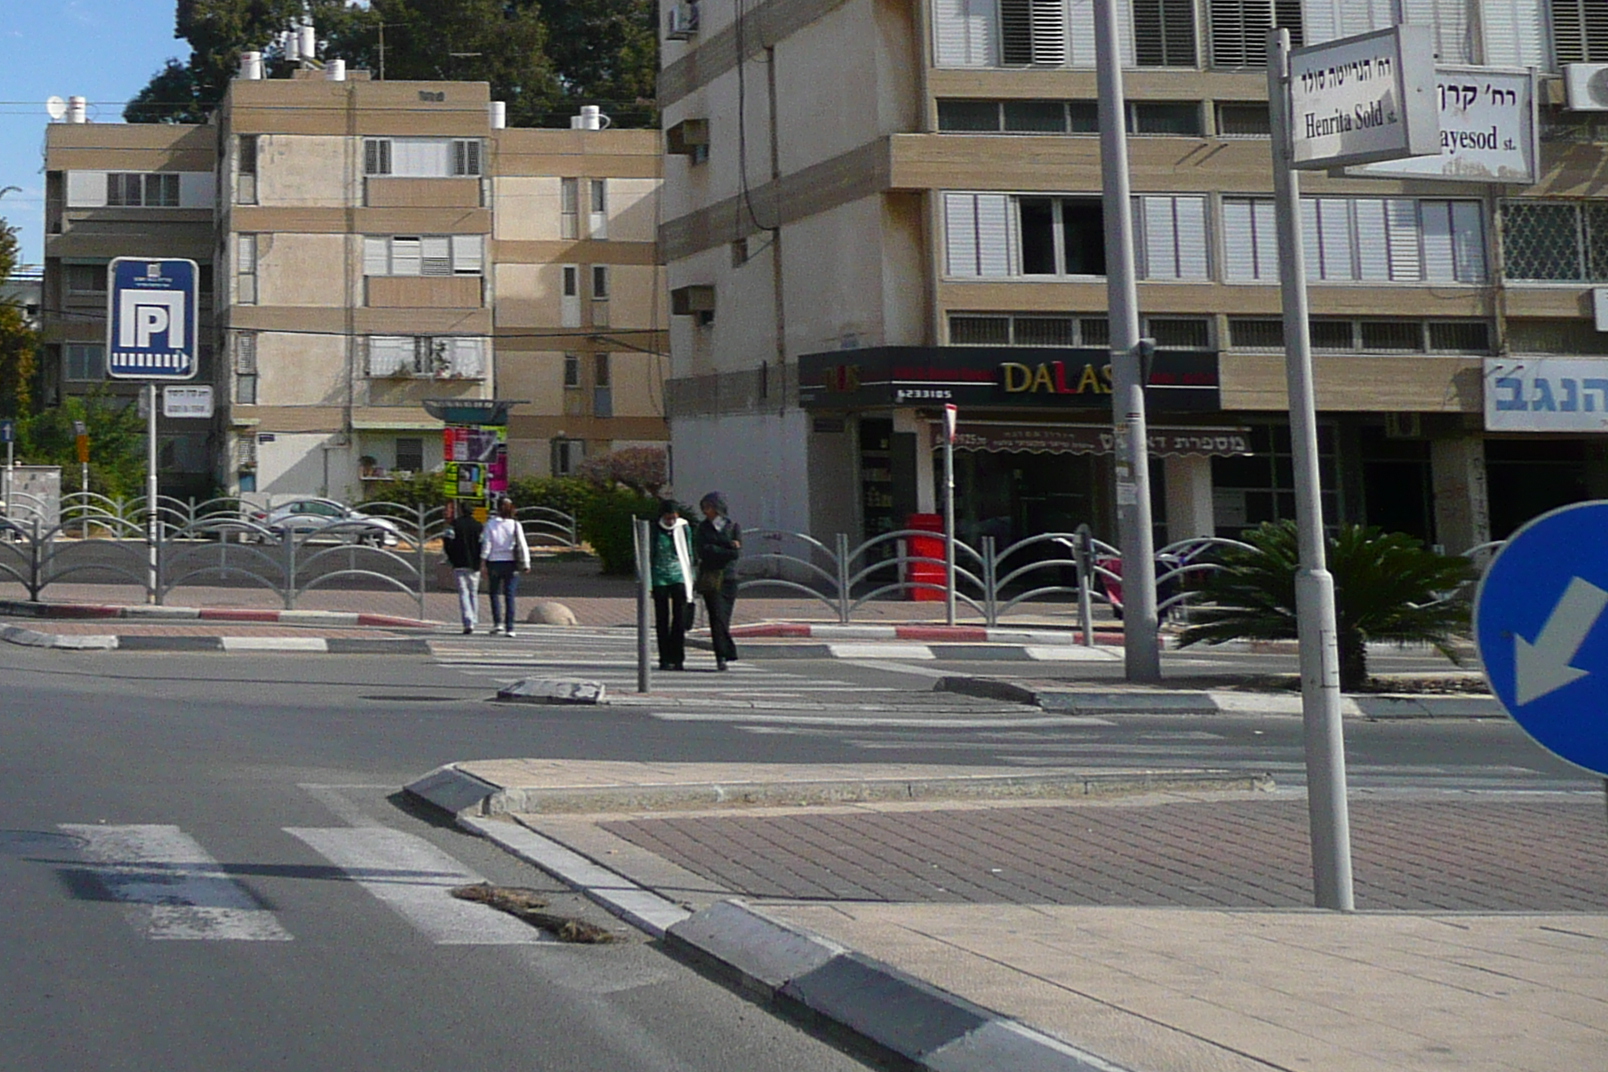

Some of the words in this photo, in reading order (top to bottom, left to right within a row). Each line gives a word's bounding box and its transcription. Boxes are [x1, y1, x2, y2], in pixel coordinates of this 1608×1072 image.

[1301, 68, 1326, 95] סולד
[1437, 84, 1478, 112] קרן
[1305, 108, 1352, 139] Henrita
[1354, 99, 1384, 130] Sold
[1387, 110, 1398, 125] st.
[1440, 126, 1497, 155] ayesod
[1503, 137, 1517, 151] st.
